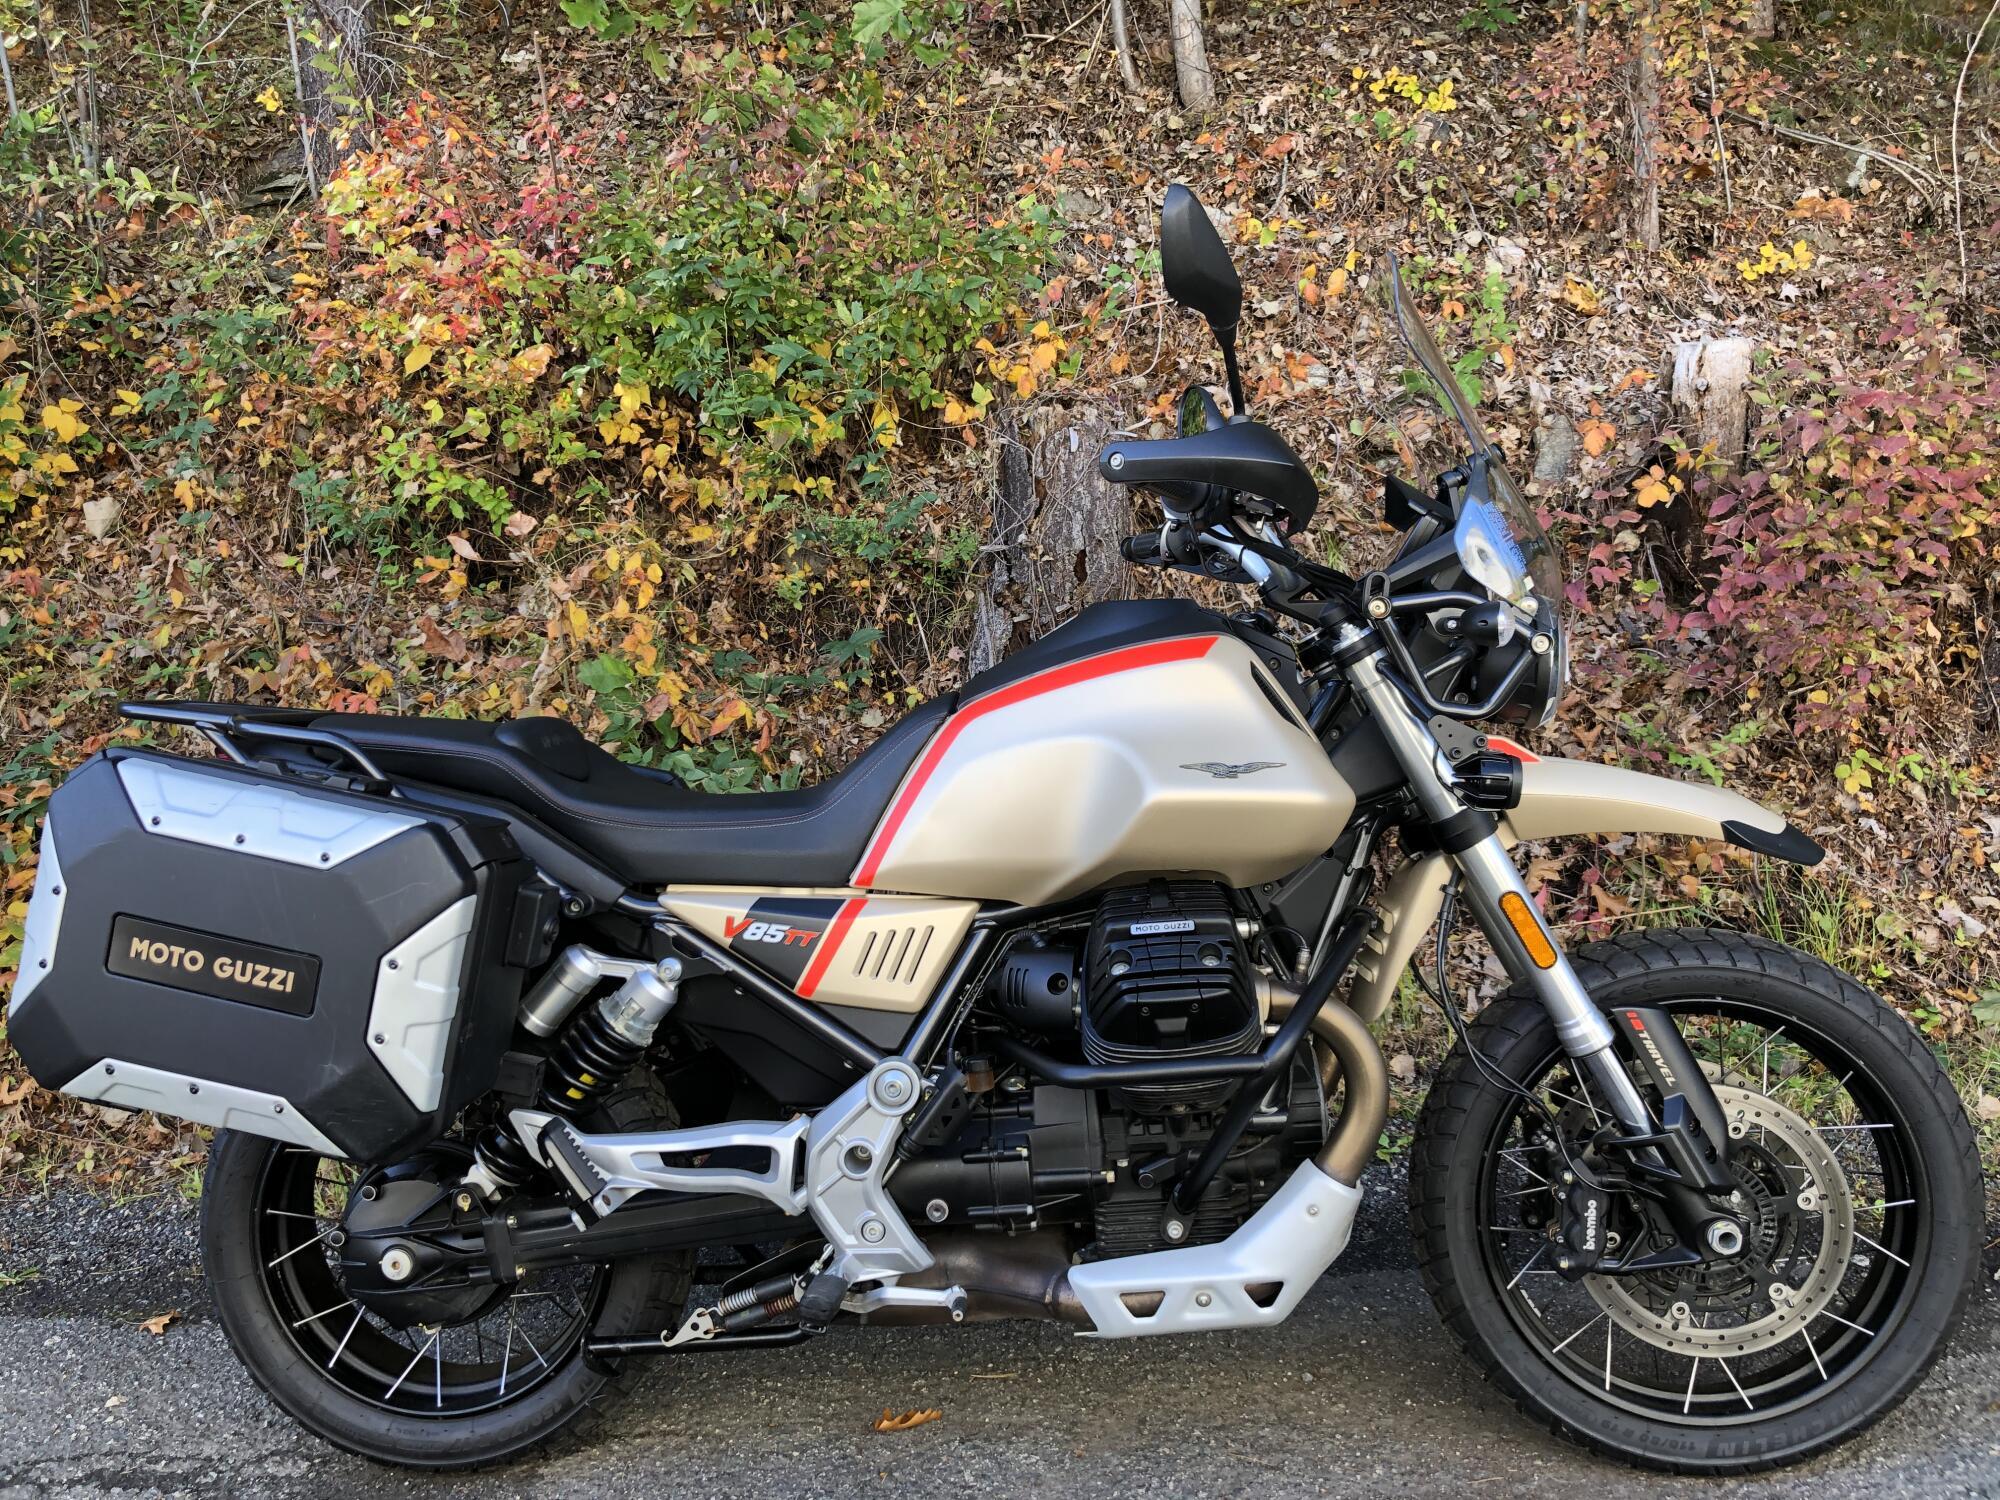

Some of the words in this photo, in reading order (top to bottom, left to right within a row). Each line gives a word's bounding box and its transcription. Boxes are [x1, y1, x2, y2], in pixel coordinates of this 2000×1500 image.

[1135, 924, 1161, 932] MOTO
[1163, 922, 1190, 930] GUZZI
[129, 936, 205, 972] MOTO
[212, 956, 295, 993] GUZZI
[1637, 1030, 1677, 1087] TRAVEL
[1583, 1199, 1598, 1251] brembo
[1716, 1396, 1863, 1457] MICHELIN
